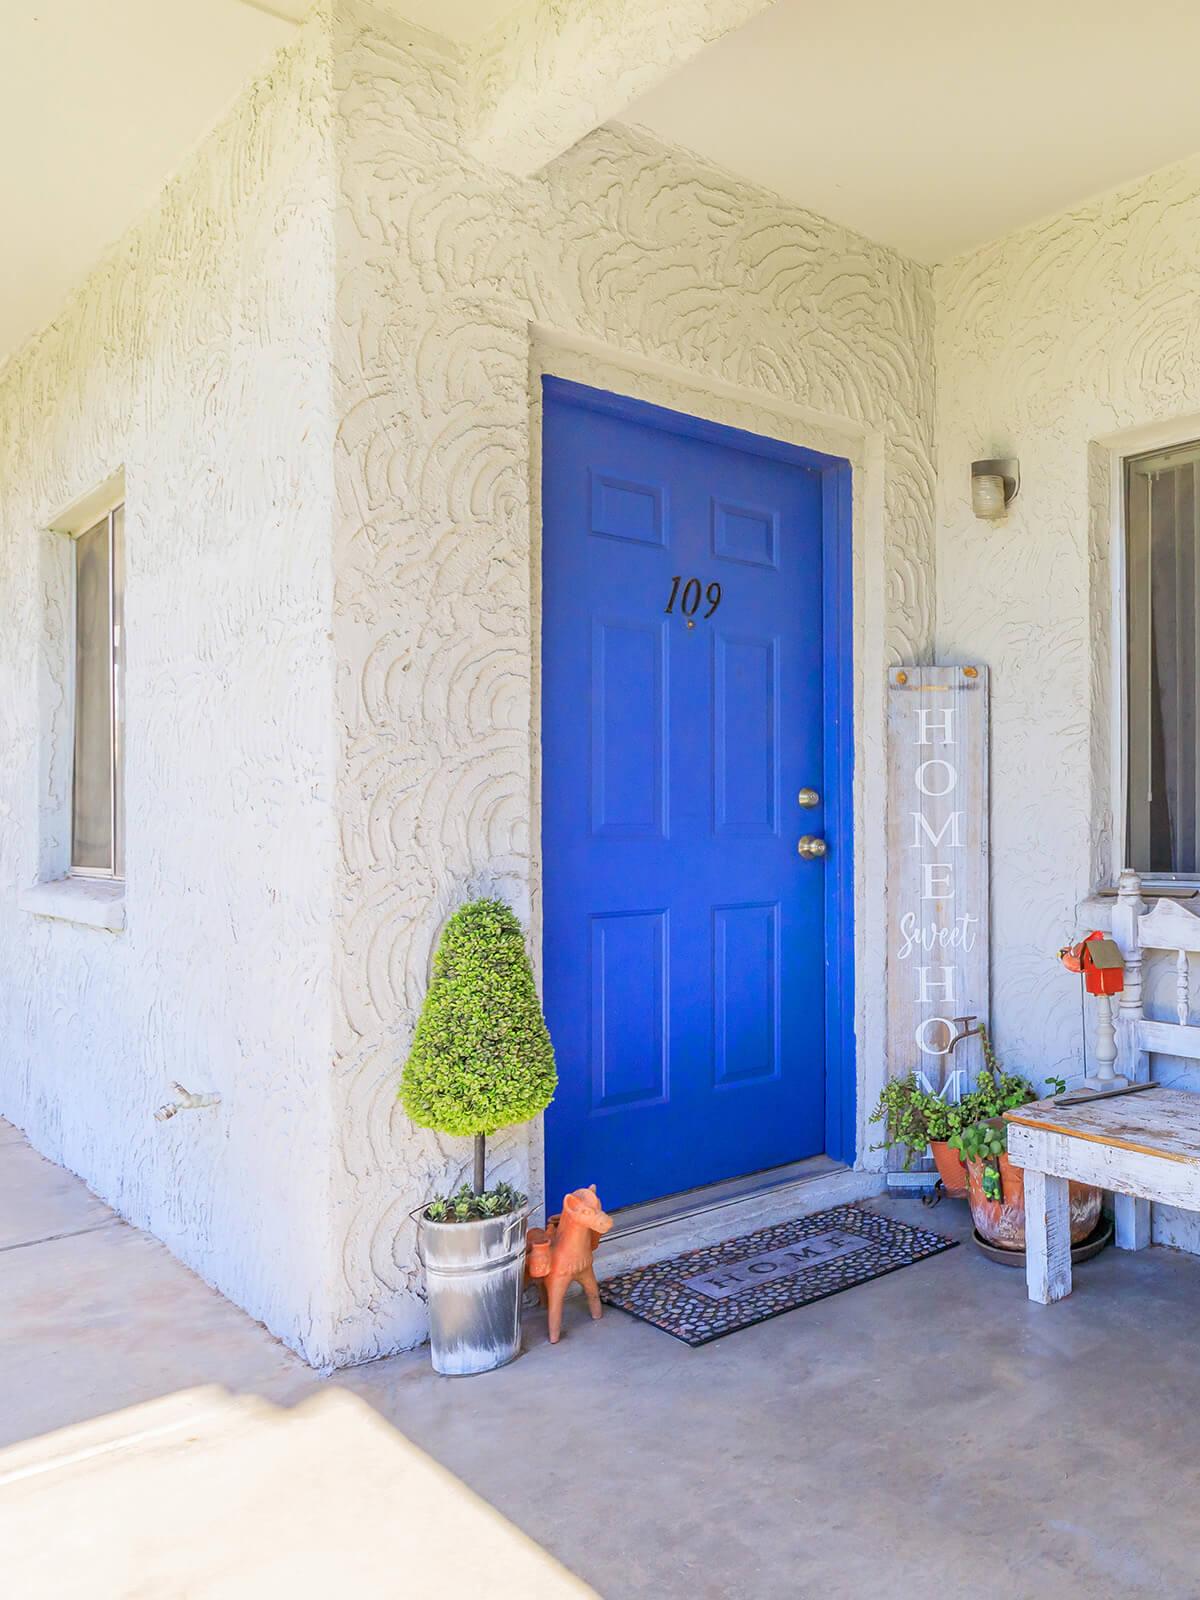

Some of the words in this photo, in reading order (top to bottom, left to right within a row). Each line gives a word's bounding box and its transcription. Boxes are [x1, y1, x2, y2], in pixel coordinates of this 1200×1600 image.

[664, 576, 721, 619] 109
[909, 708, 966, 900] HOME
[897, 912, 979, 959] Sweet
[912, 965, 967, 1158] HOM
[704, 1236, 845, 1290] HOME
